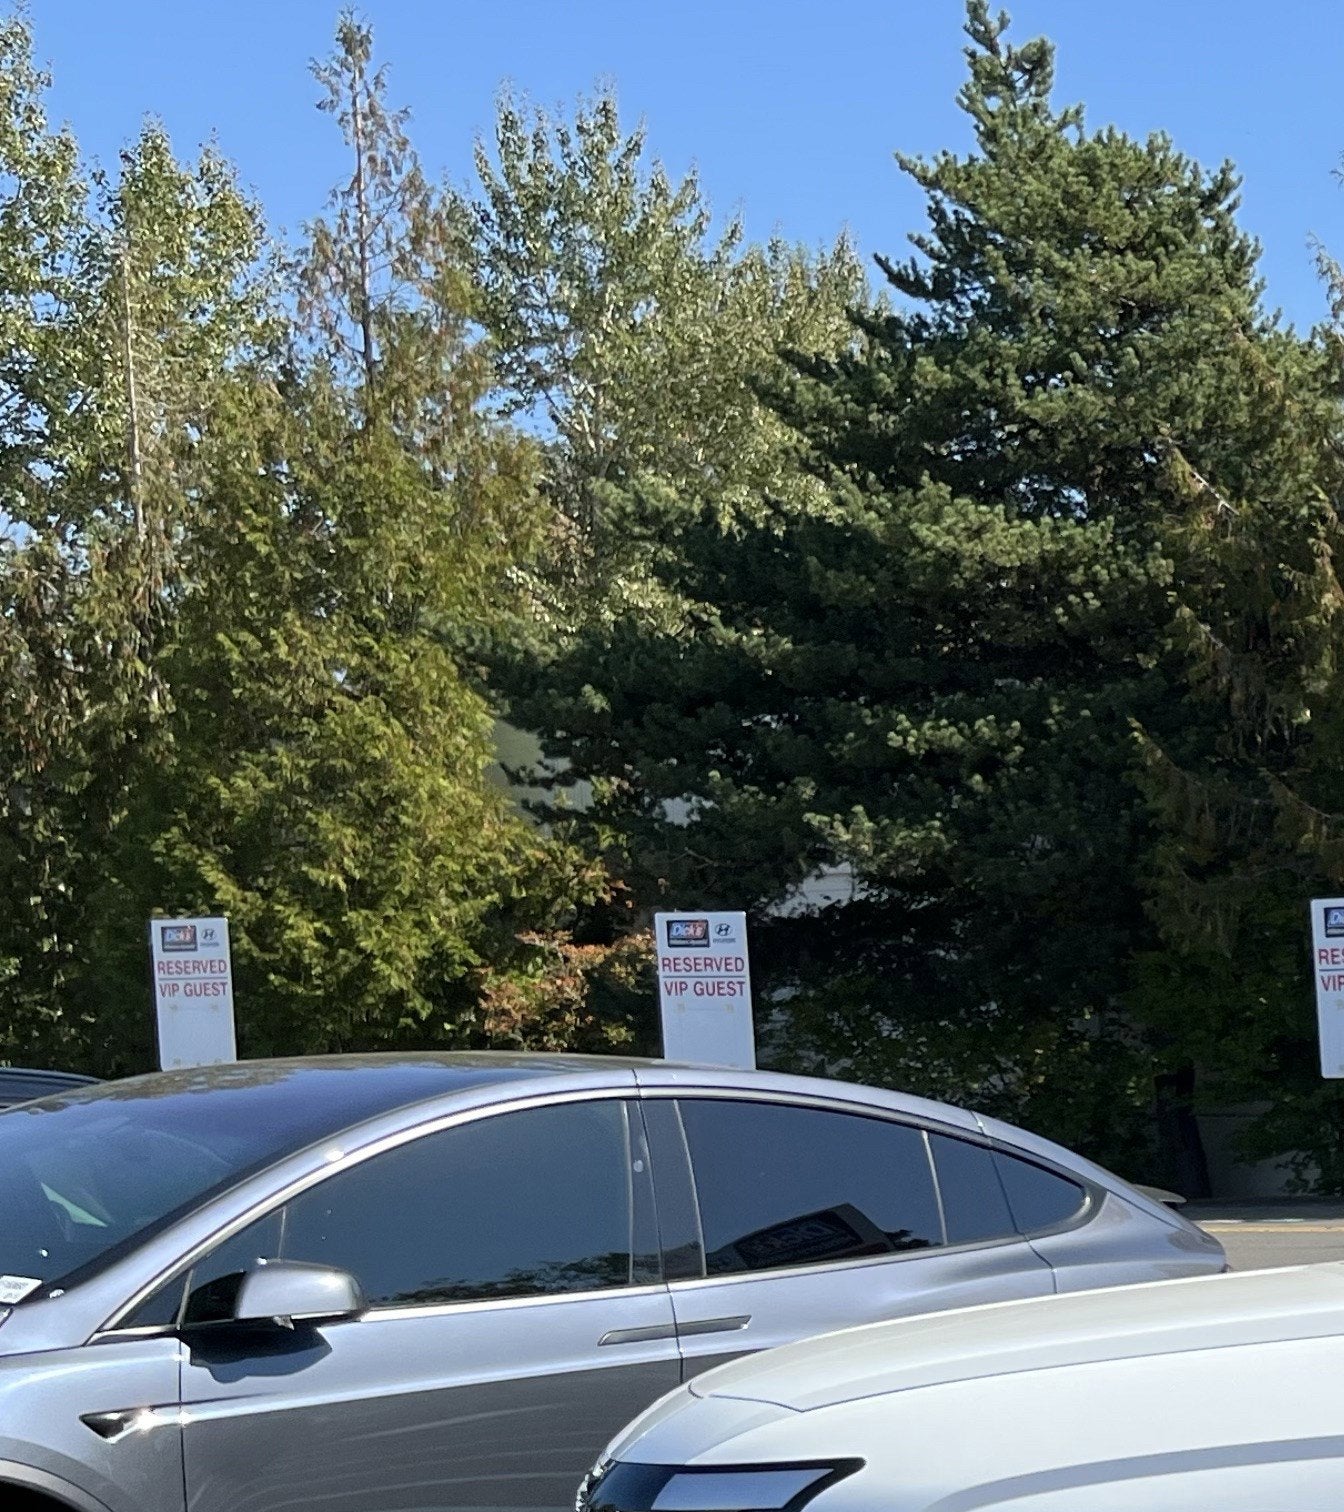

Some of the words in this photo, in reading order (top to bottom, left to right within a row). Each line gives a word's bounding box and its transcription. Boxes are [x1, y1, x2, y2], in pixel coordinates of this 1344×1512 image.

[157, 959, 227, 975] RESERVED
[661, 956, 745, 972] RESERVED
[159, 983, 180, 997] VIP
[184, 981, 228, 997] GUEST
[664, 981, 688, 997] VIP
[693, 980, 746, 997] GUEST
